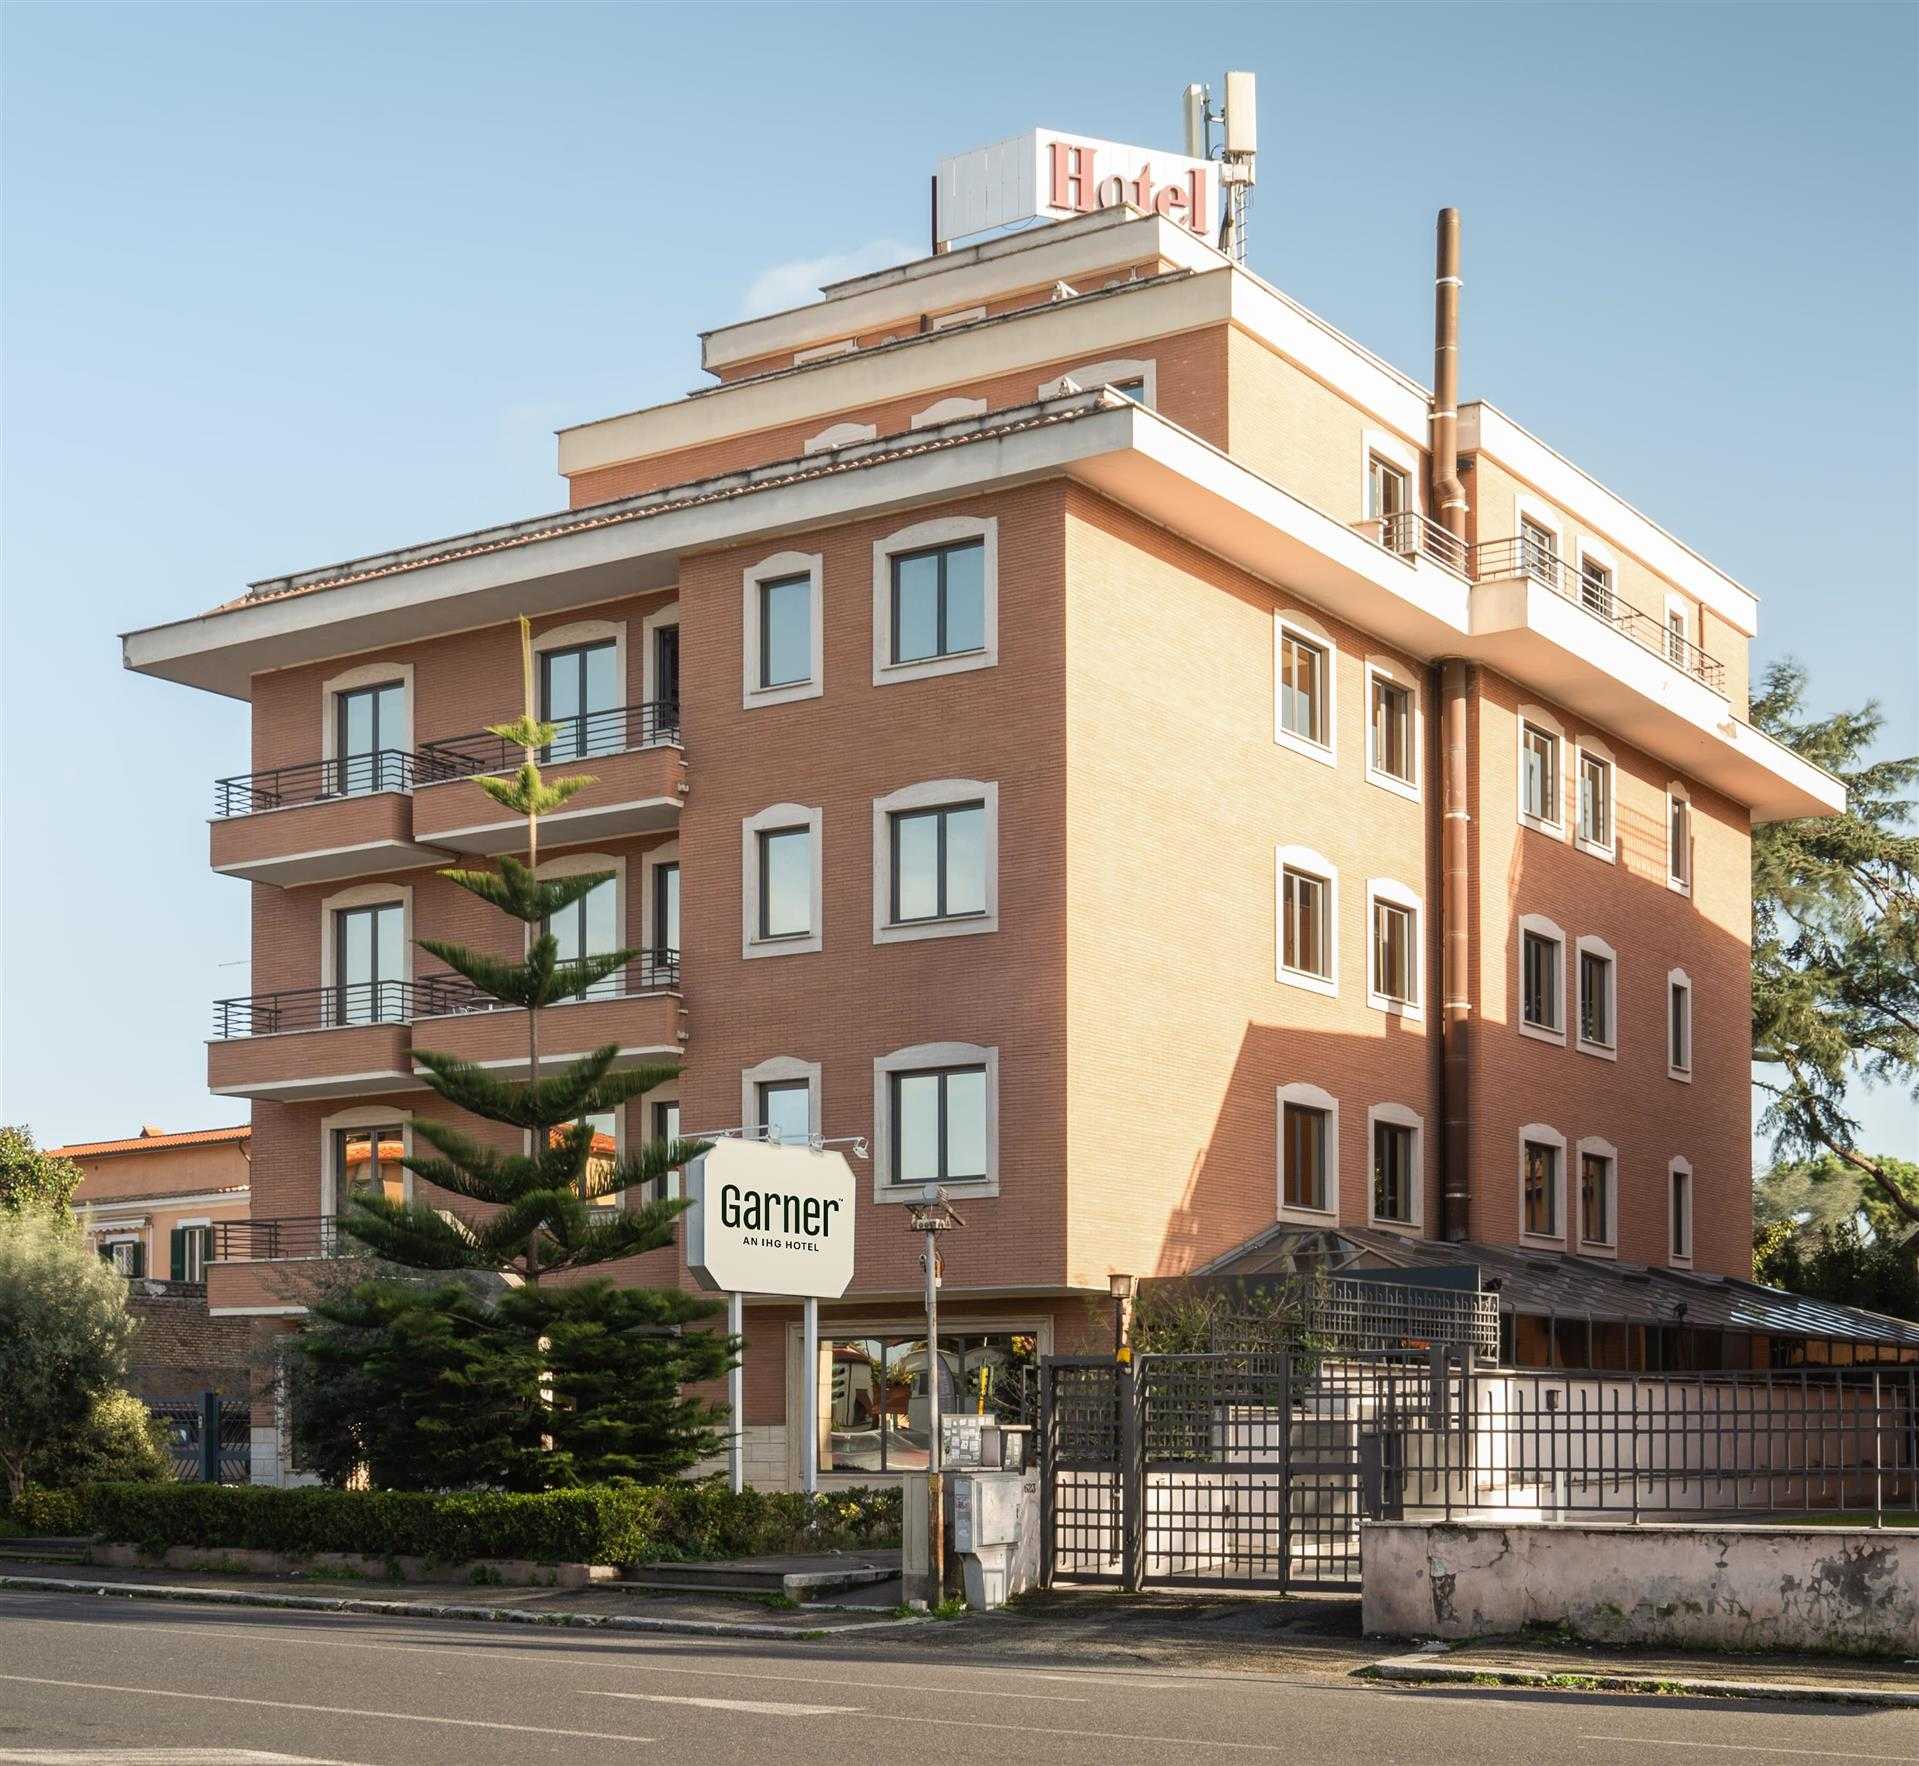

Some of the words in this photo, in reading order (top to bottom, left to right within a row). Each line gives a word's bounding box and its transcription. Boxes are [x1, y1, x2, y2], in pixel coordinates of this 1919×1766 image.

[1048, 142, 1208, 235] Hotel
[742, 1236, 758, 1246] AN
[761, 1238, 782, 1249] IHG
[785, 1240, 820, 1252] HOTEL
